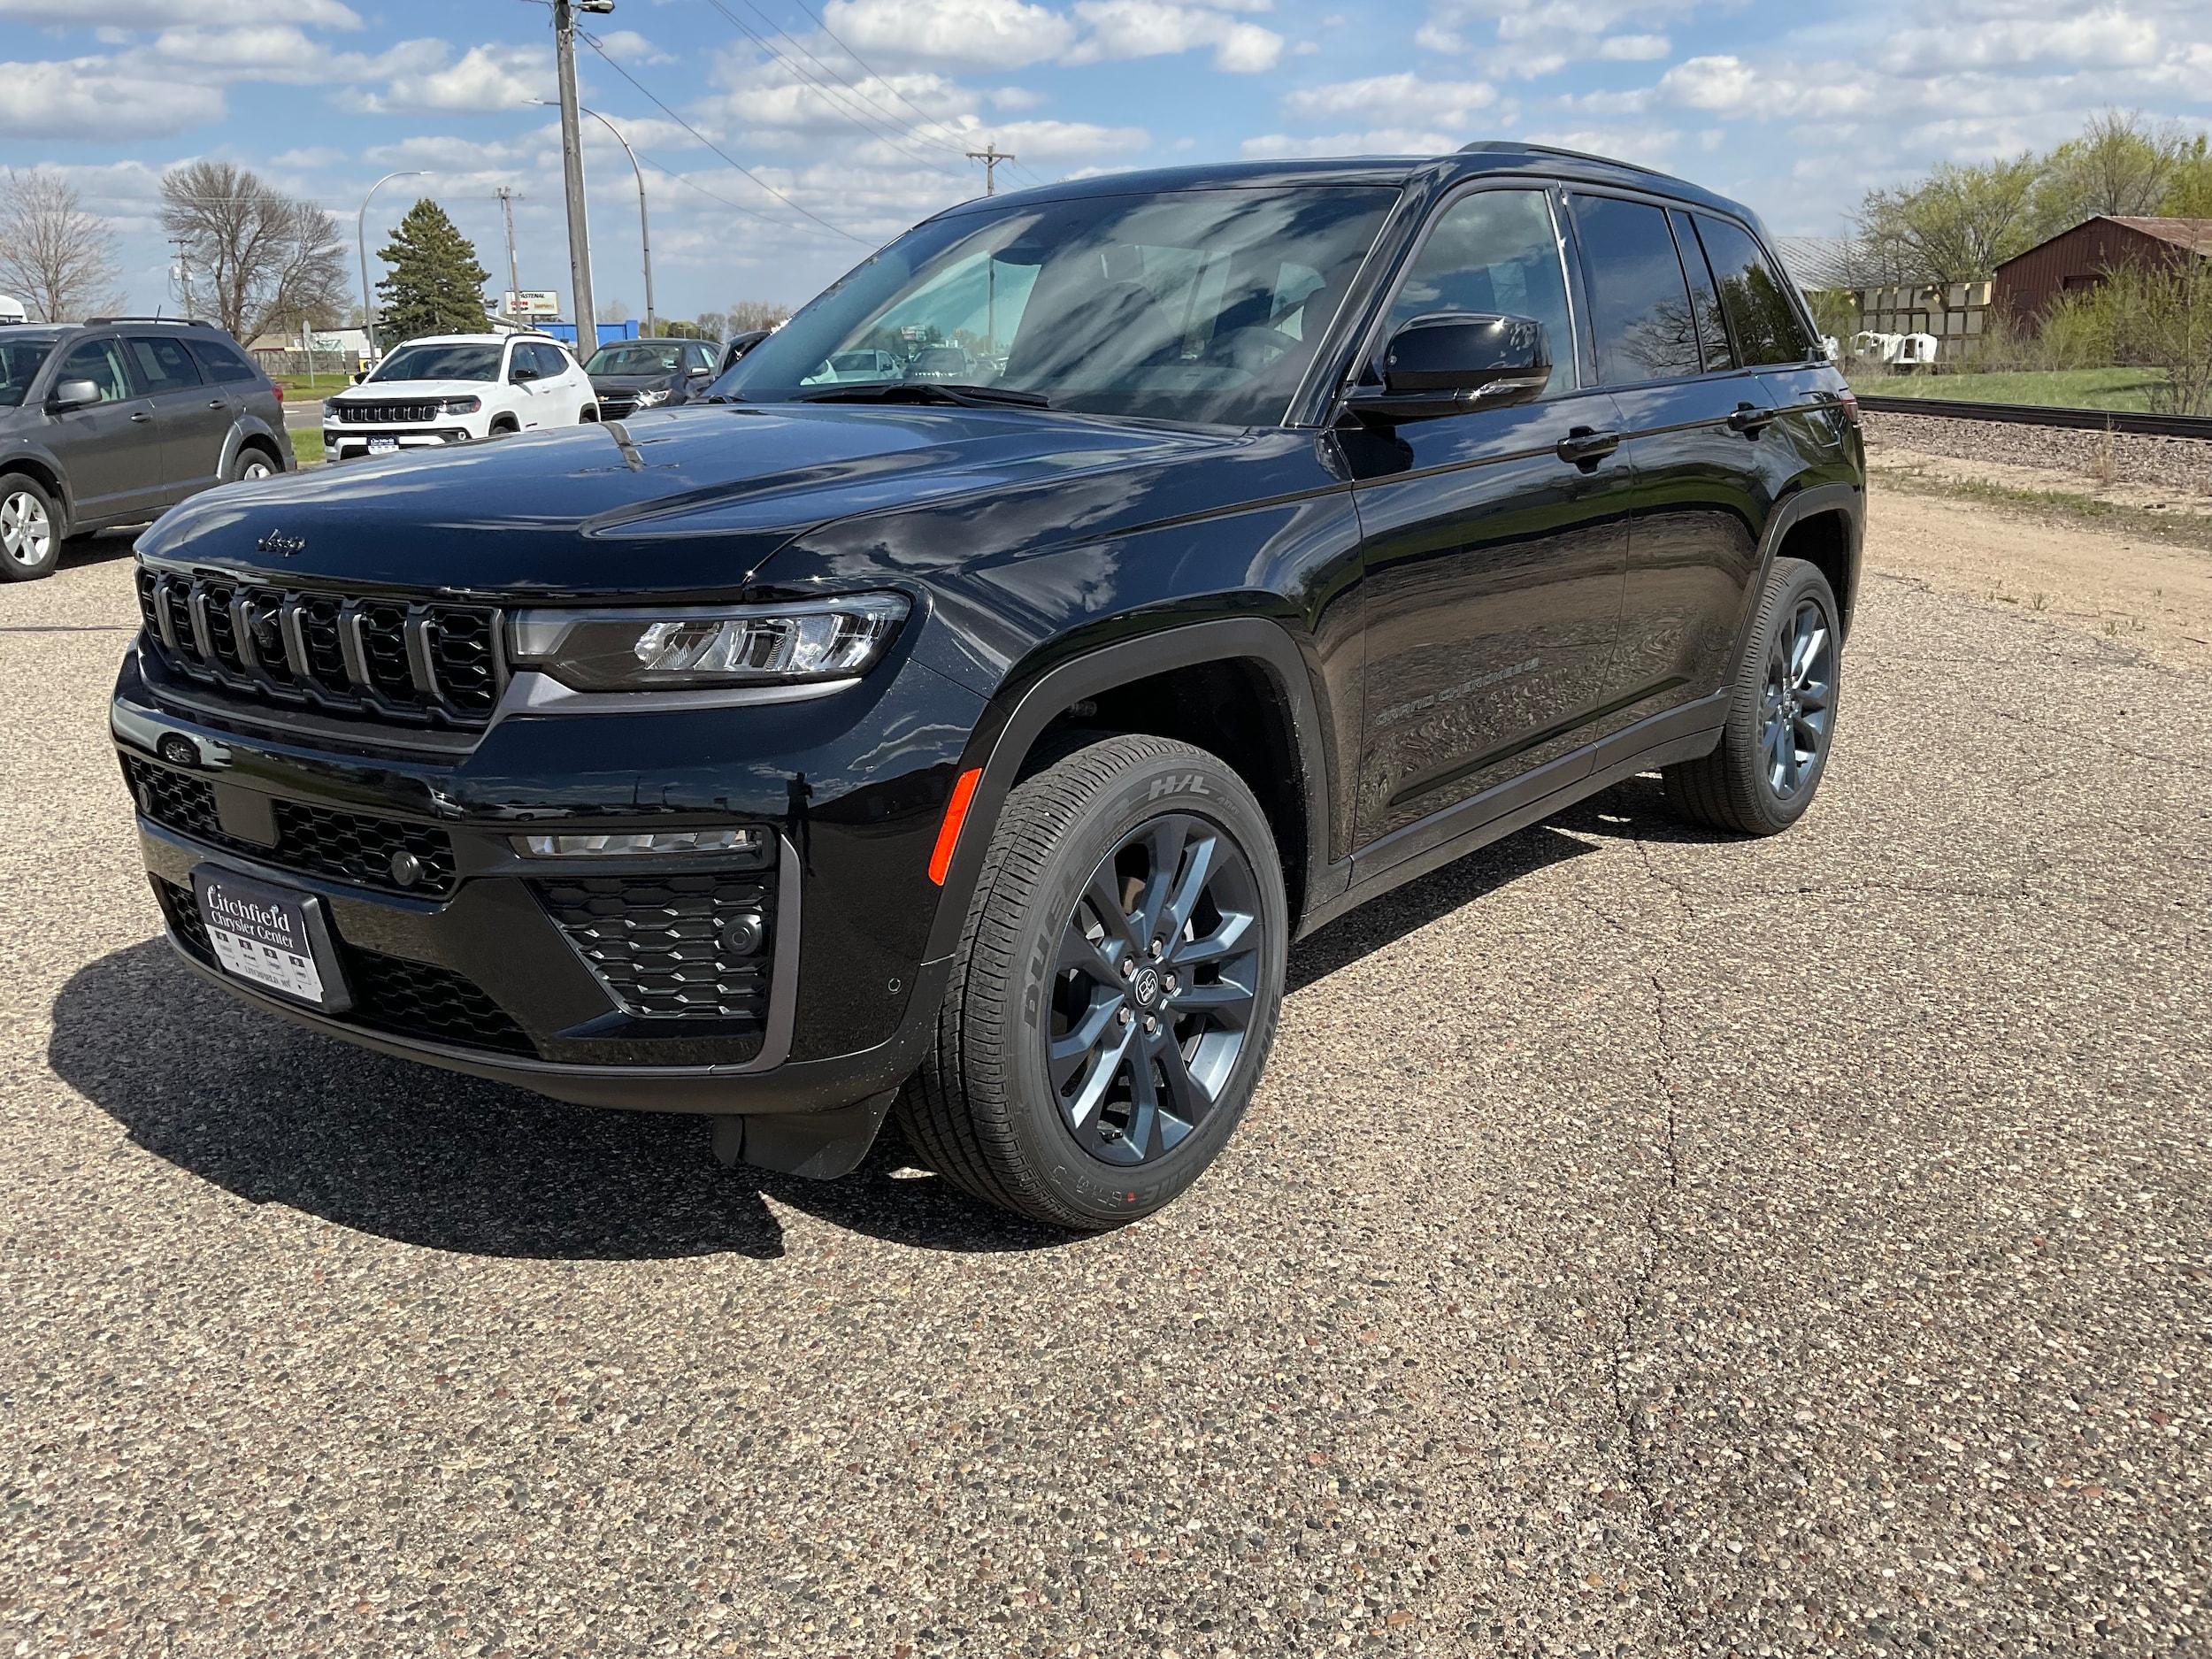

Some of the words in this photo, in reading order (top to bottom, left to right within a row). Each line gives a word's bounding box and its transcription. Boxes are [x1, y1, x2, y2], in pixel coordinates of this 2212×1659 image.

[256, 528, 306, 558] Jeep
[1376, 695, 1435, 726] GRAND
[1438, 664, 1523, 702] CHEROKEE
[1148, 774, 1210, 802] H/L
[206, 885, 291, 933] Litchfield
[211, 910, 256, 937] Chrysler
[257, 926, 295, 949] Center
